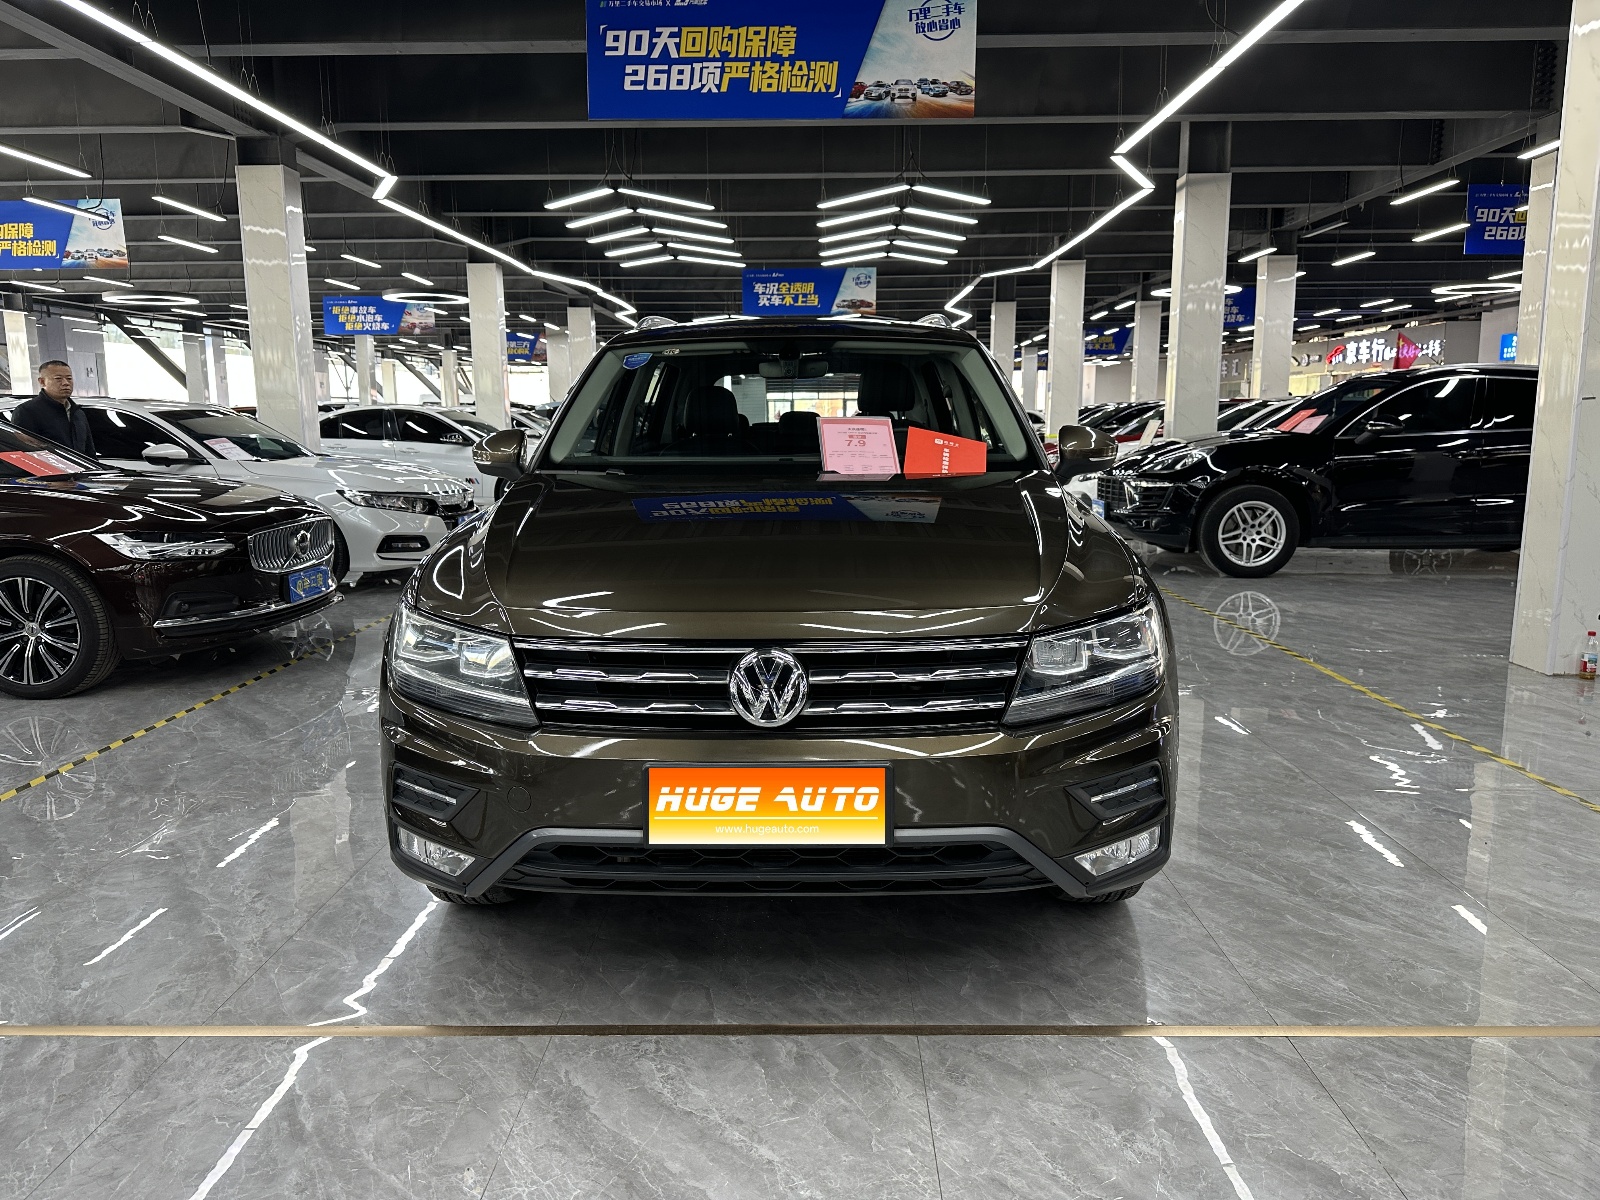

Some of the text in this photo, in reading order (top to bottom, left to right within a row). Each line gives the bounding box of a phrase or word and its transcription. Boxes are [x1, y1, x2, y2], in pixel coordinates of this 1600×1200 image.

[907, 2, 966, 22] 万里二手车
[915, 17, 961, 34] 放心省心
[604, 26, 797, 58] 90天回购保障
[623, 61, 839, 93] 268项严格检测
[753, 282, 815, 294] 车况全透明
[758, 294, 819, 306] 买车不上当
[332, 306, 377, 314] 拒绝事故车
[338, 314, 383, 323] 拒绝水泡车
[345, 322, 390, 331] 拒绝火烧车
[844, 439, 867, 447] 7.9
